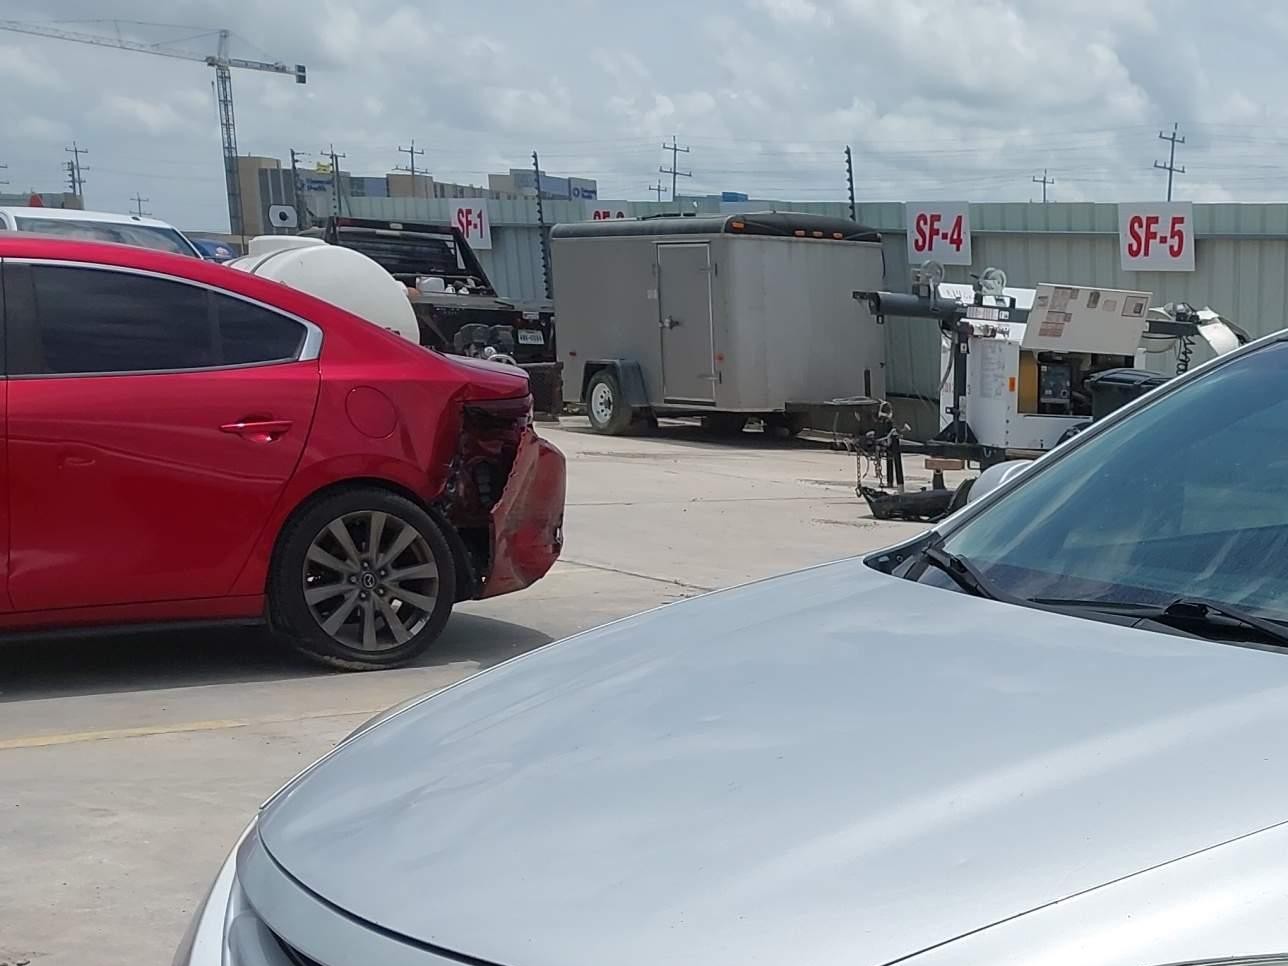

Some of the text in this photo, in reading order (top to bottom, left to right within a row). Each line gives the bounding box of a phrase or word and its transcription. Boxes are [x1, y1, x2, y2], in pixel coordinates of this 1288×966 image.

[457, 208, 484, 239] SF-1
[914, 213, 963, 252] SF-4
[1127, 215, 1185, 258] SF-5
